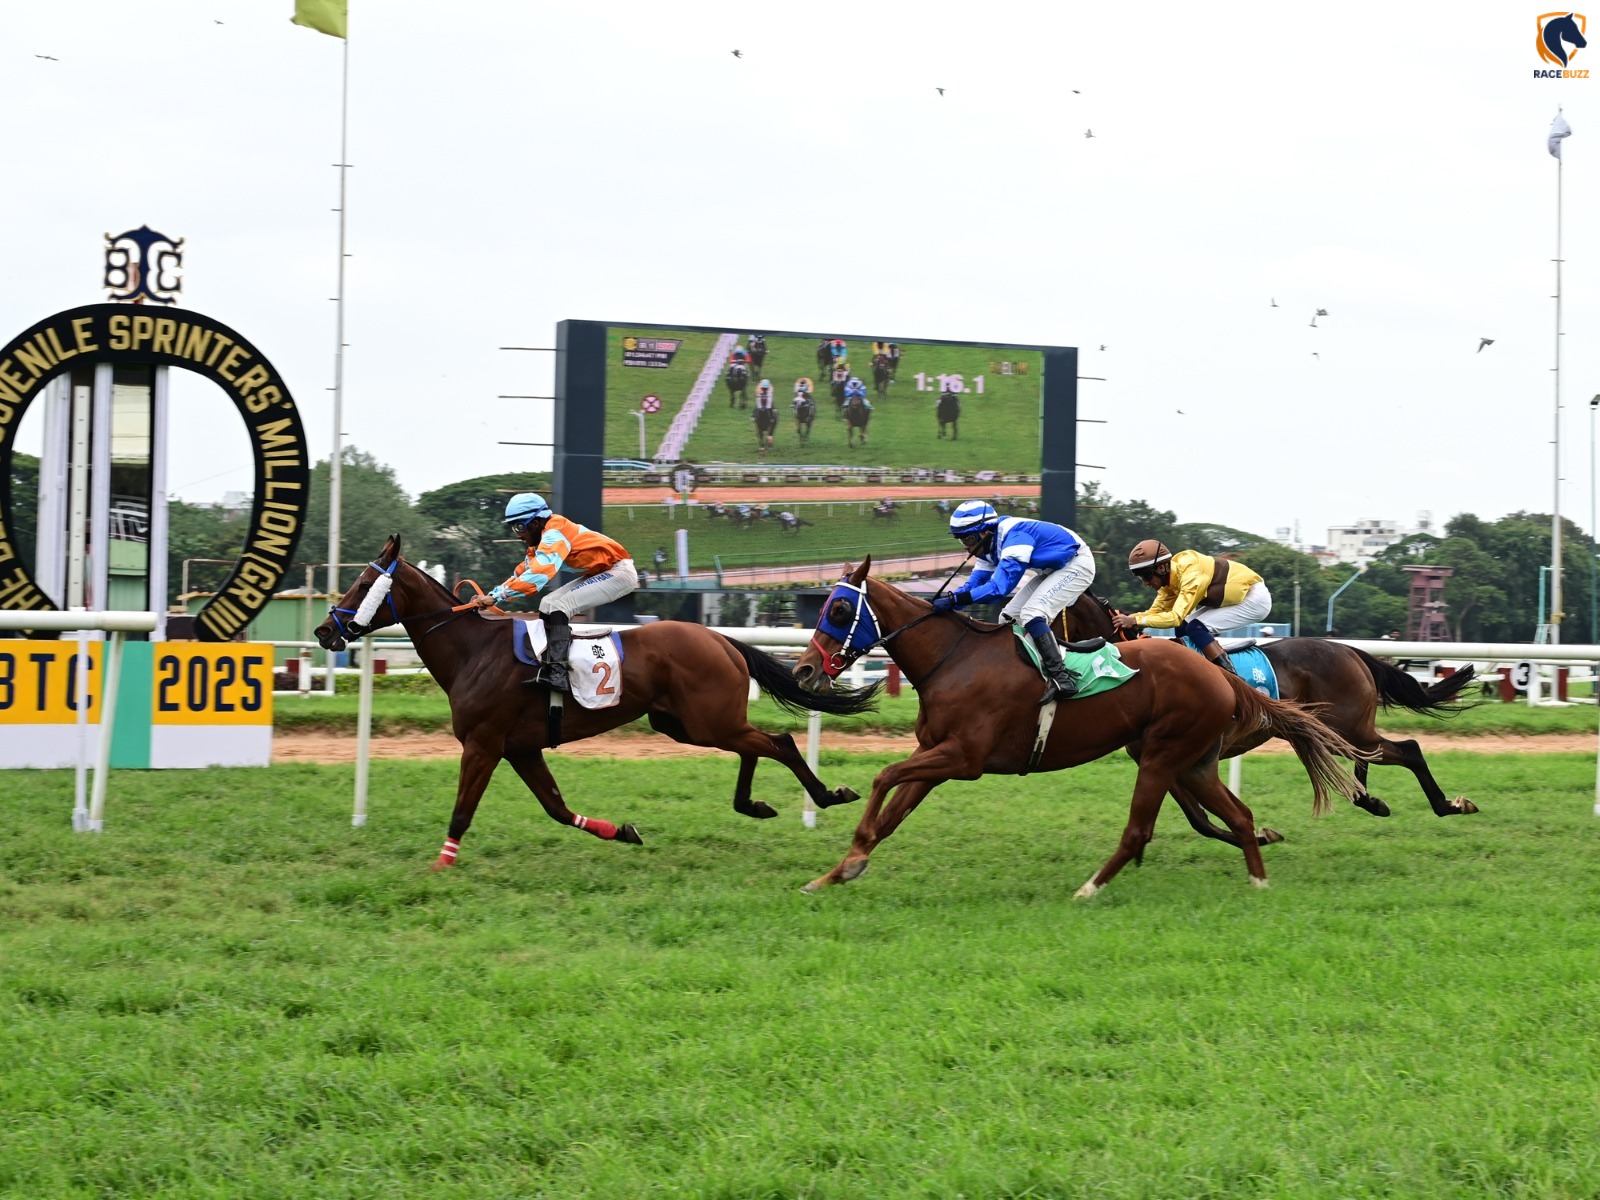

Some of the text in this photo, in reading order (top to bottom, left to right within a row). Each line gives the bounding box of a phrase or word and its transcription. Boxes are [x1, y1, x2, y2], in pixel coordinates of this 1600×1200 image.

[913, 372, 985, 394] 1:16.1
[0, 317, 99, 440] VENILE
[109, 315, 294, 414] SPRINTERS'
[253, 417, 302, 557] MILLION
[158, 655, 264, 712] 2025
[592, 661, 615, 696] 2
[1516, 662, 1531, 687] 3
